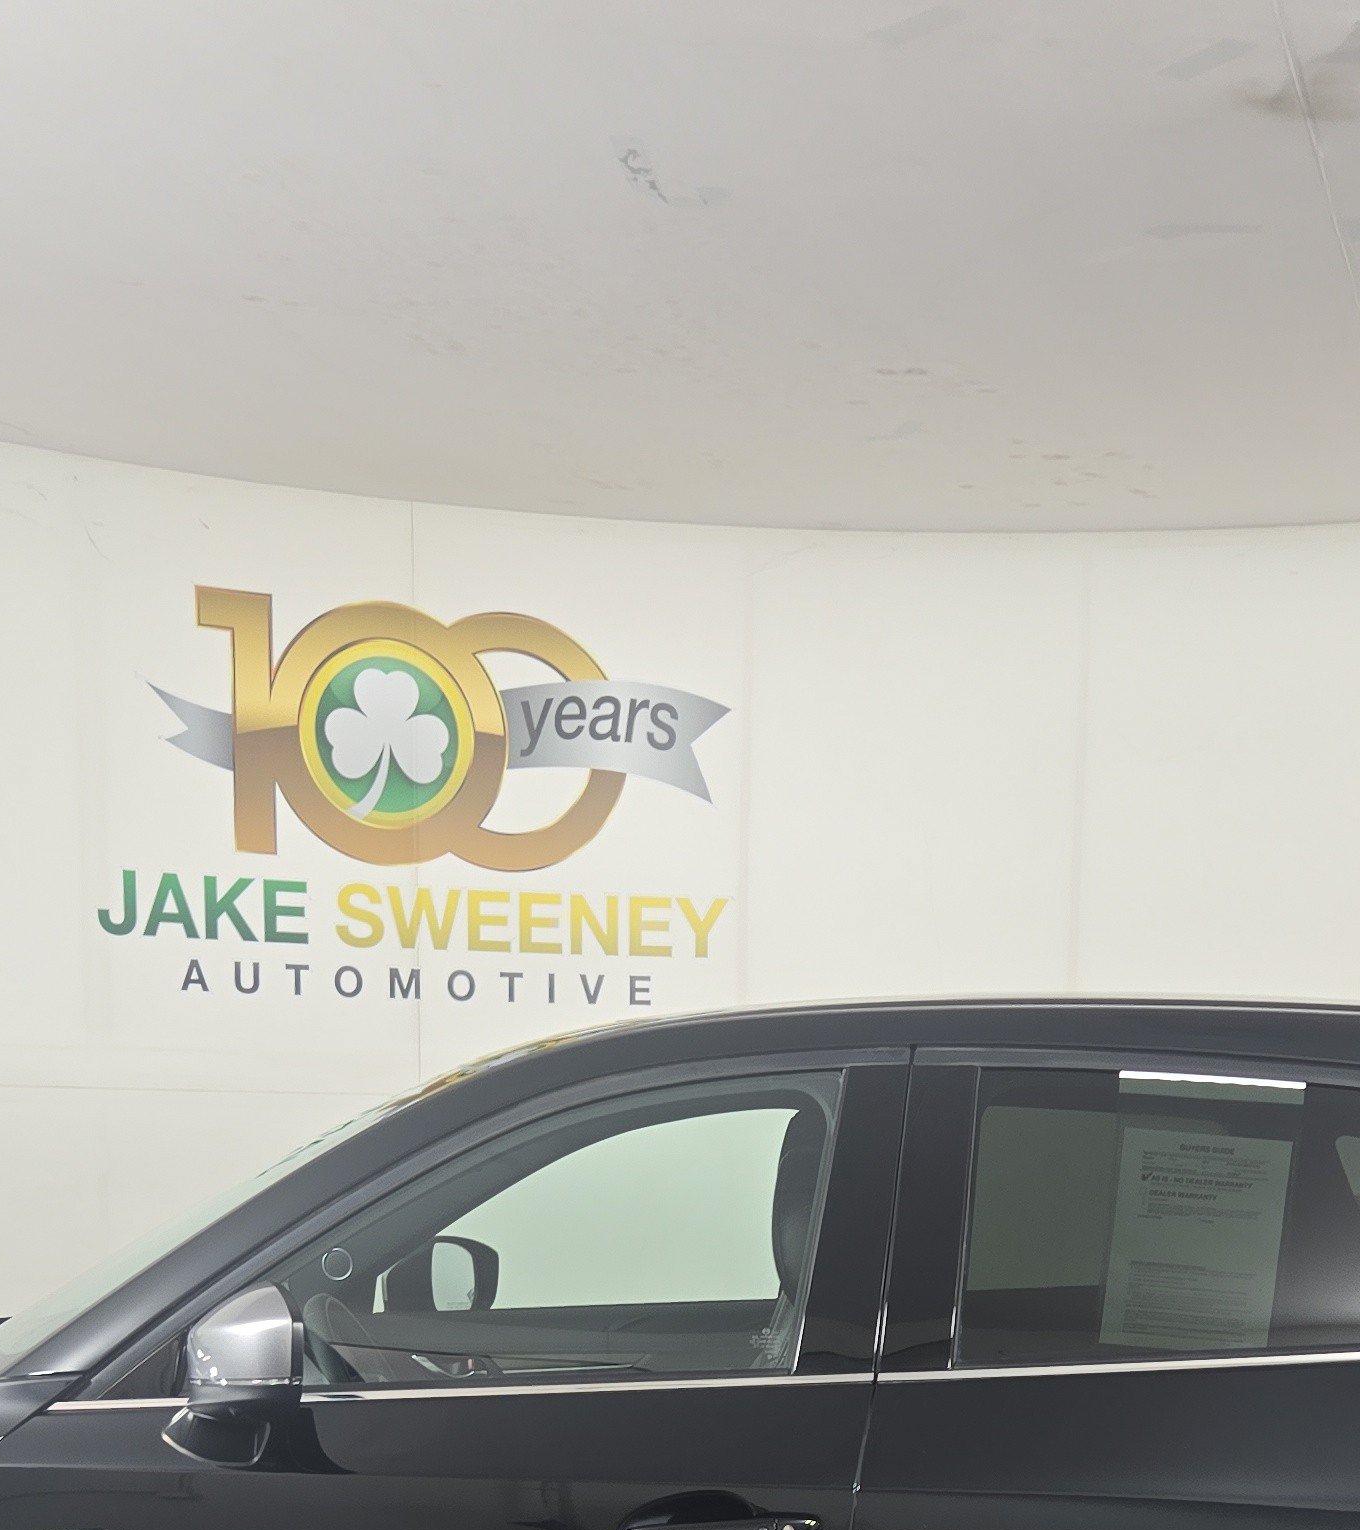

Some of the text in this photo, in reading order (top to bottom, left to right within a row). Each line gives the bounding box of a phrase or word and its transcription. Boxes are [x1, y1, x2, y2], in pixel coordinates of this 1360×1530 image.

[194, 584, 627, 873] 100
[519, 692, 680, 757] years
[97, 869, 730, 959] JAKE SWEENEY
[181, 959, 653, 1006] AUTOMOTIVE
